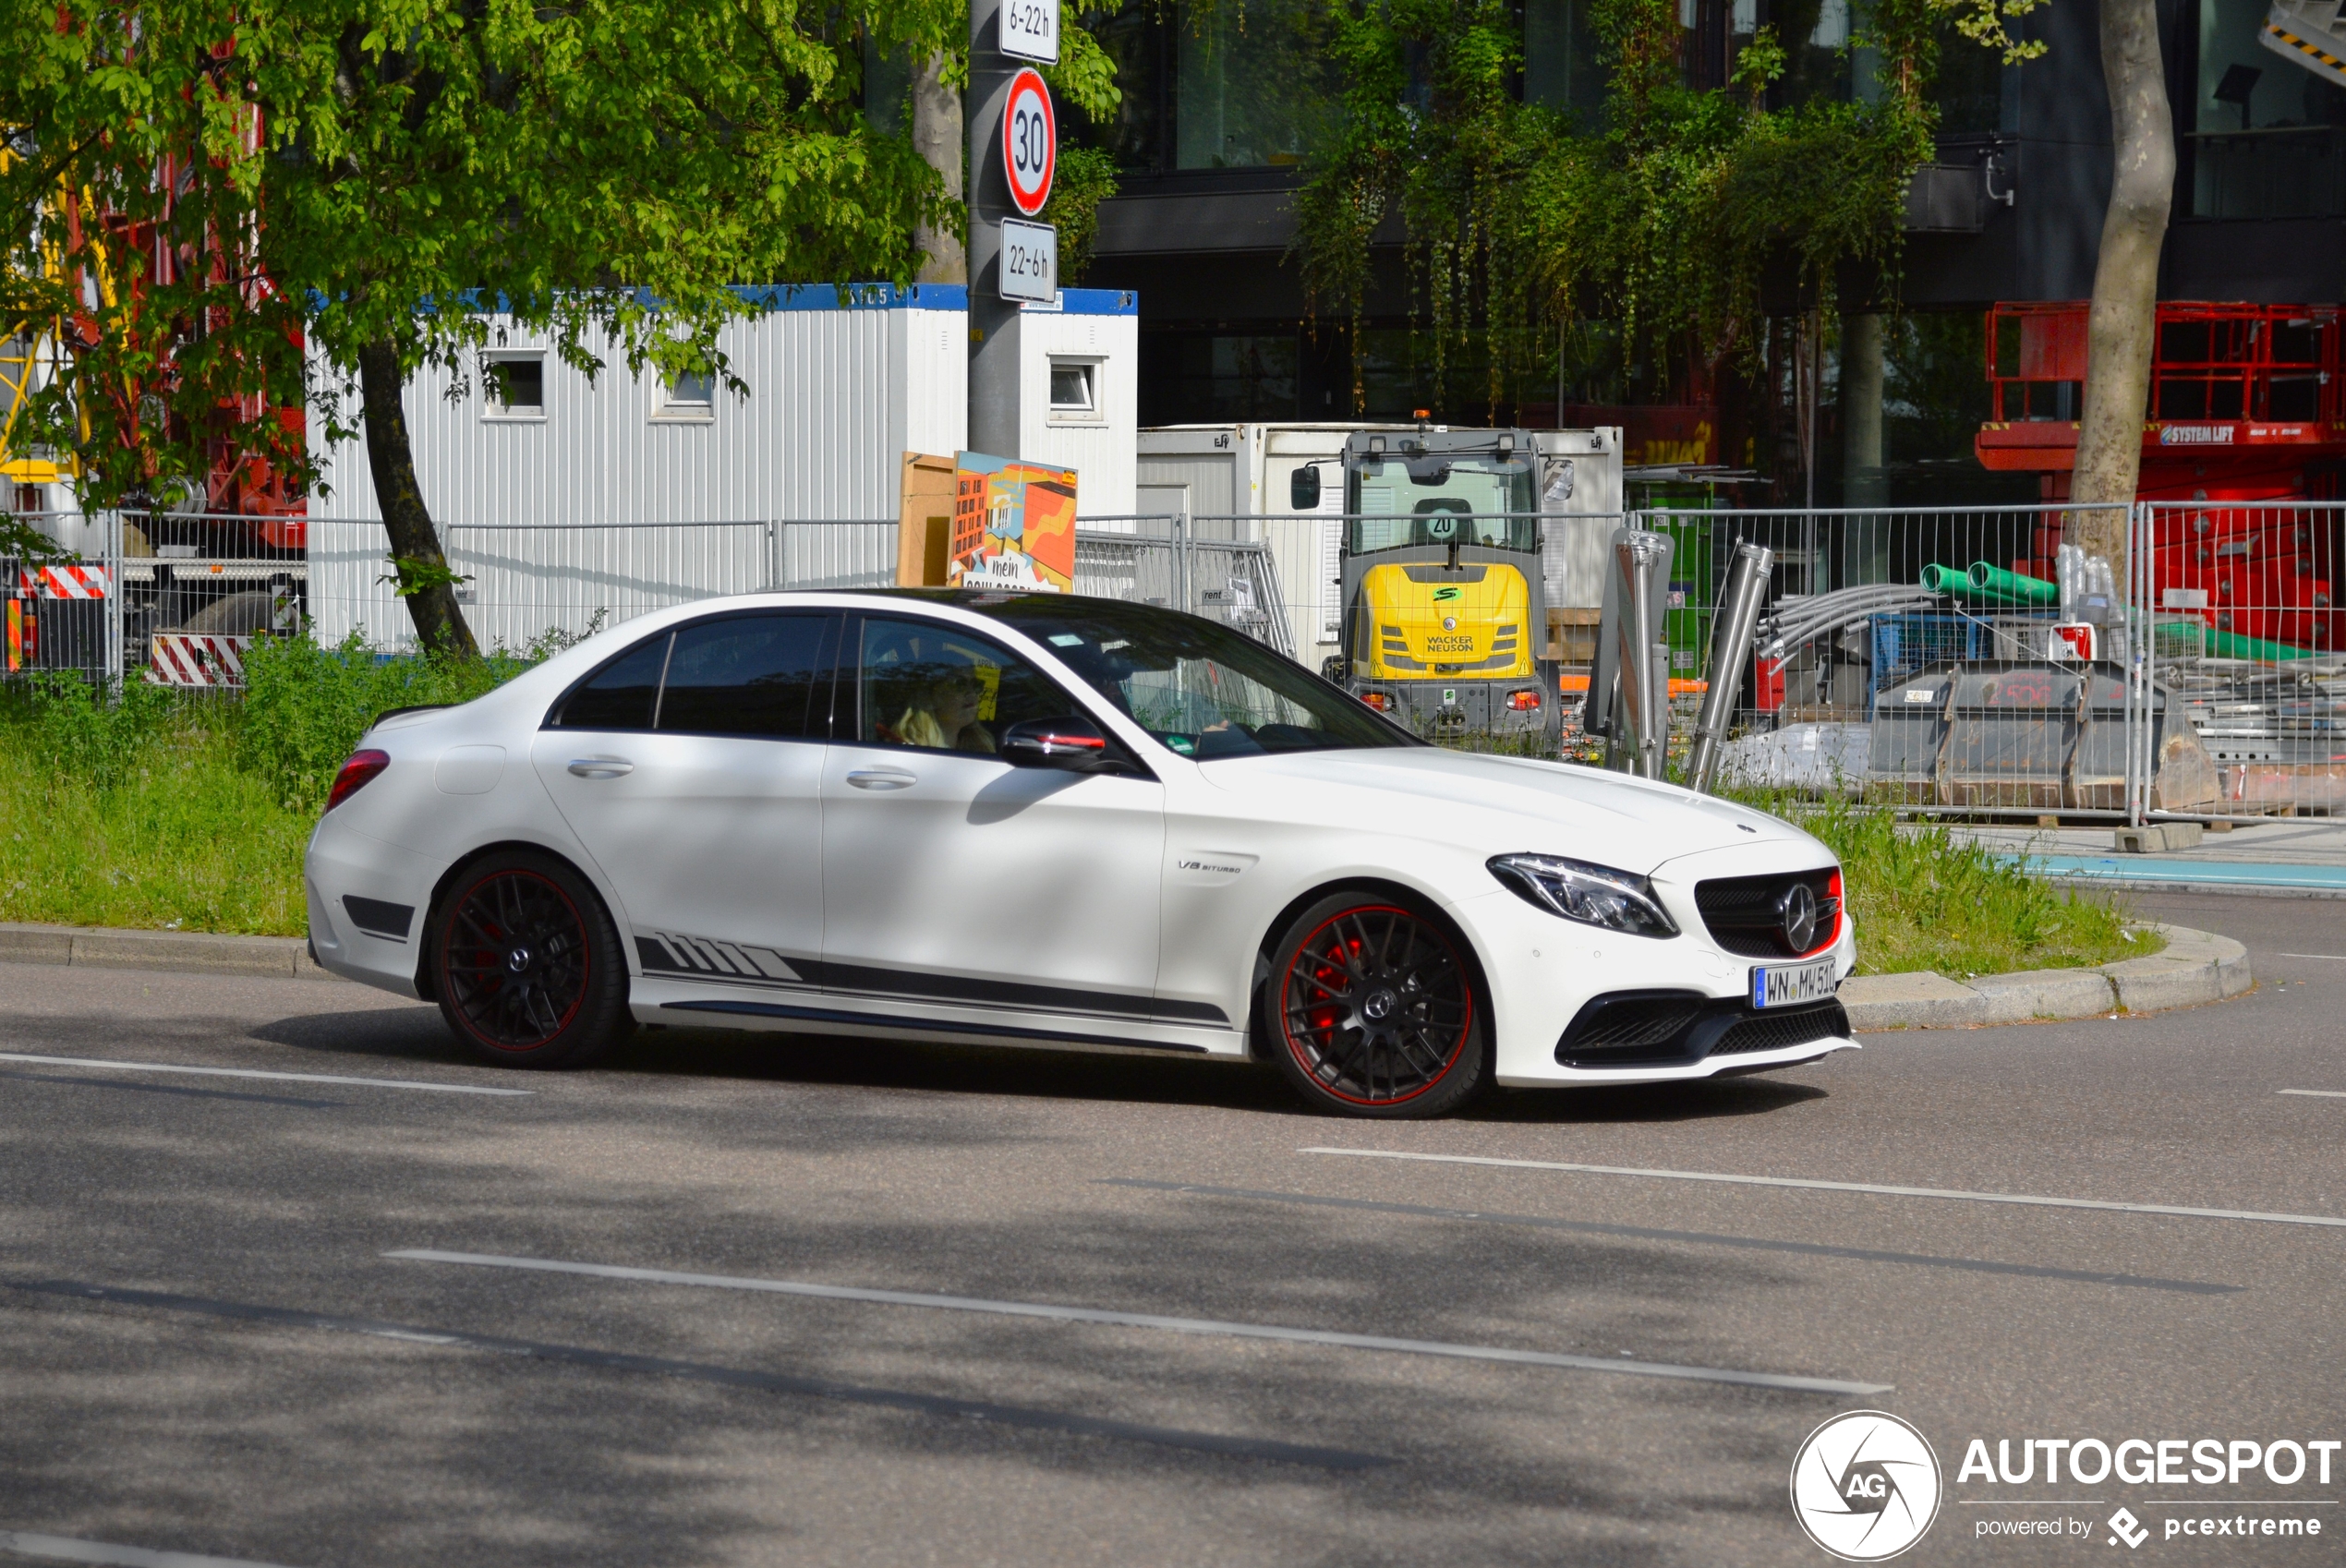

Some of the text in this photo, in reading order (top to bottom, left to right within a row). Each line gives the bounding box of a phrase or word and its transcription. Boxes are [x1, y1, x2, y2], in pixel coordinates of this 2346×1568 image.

[1015, 109, 1044, 174] 30
[2171, 426, 2211, 442] SYSTEM
[2212, 426, 2234, 442] LIFT
[992, 557, 1019, 579] mein
[1427, 635, 1473, 645] WACKER
[1427, 644, 1474, 653] NEUSON
[1179, 861, 1241, 874] V8 BITURBO
[1768, 971, 1789, 1002] WN
[1798, 967, 1817, 998] MW
